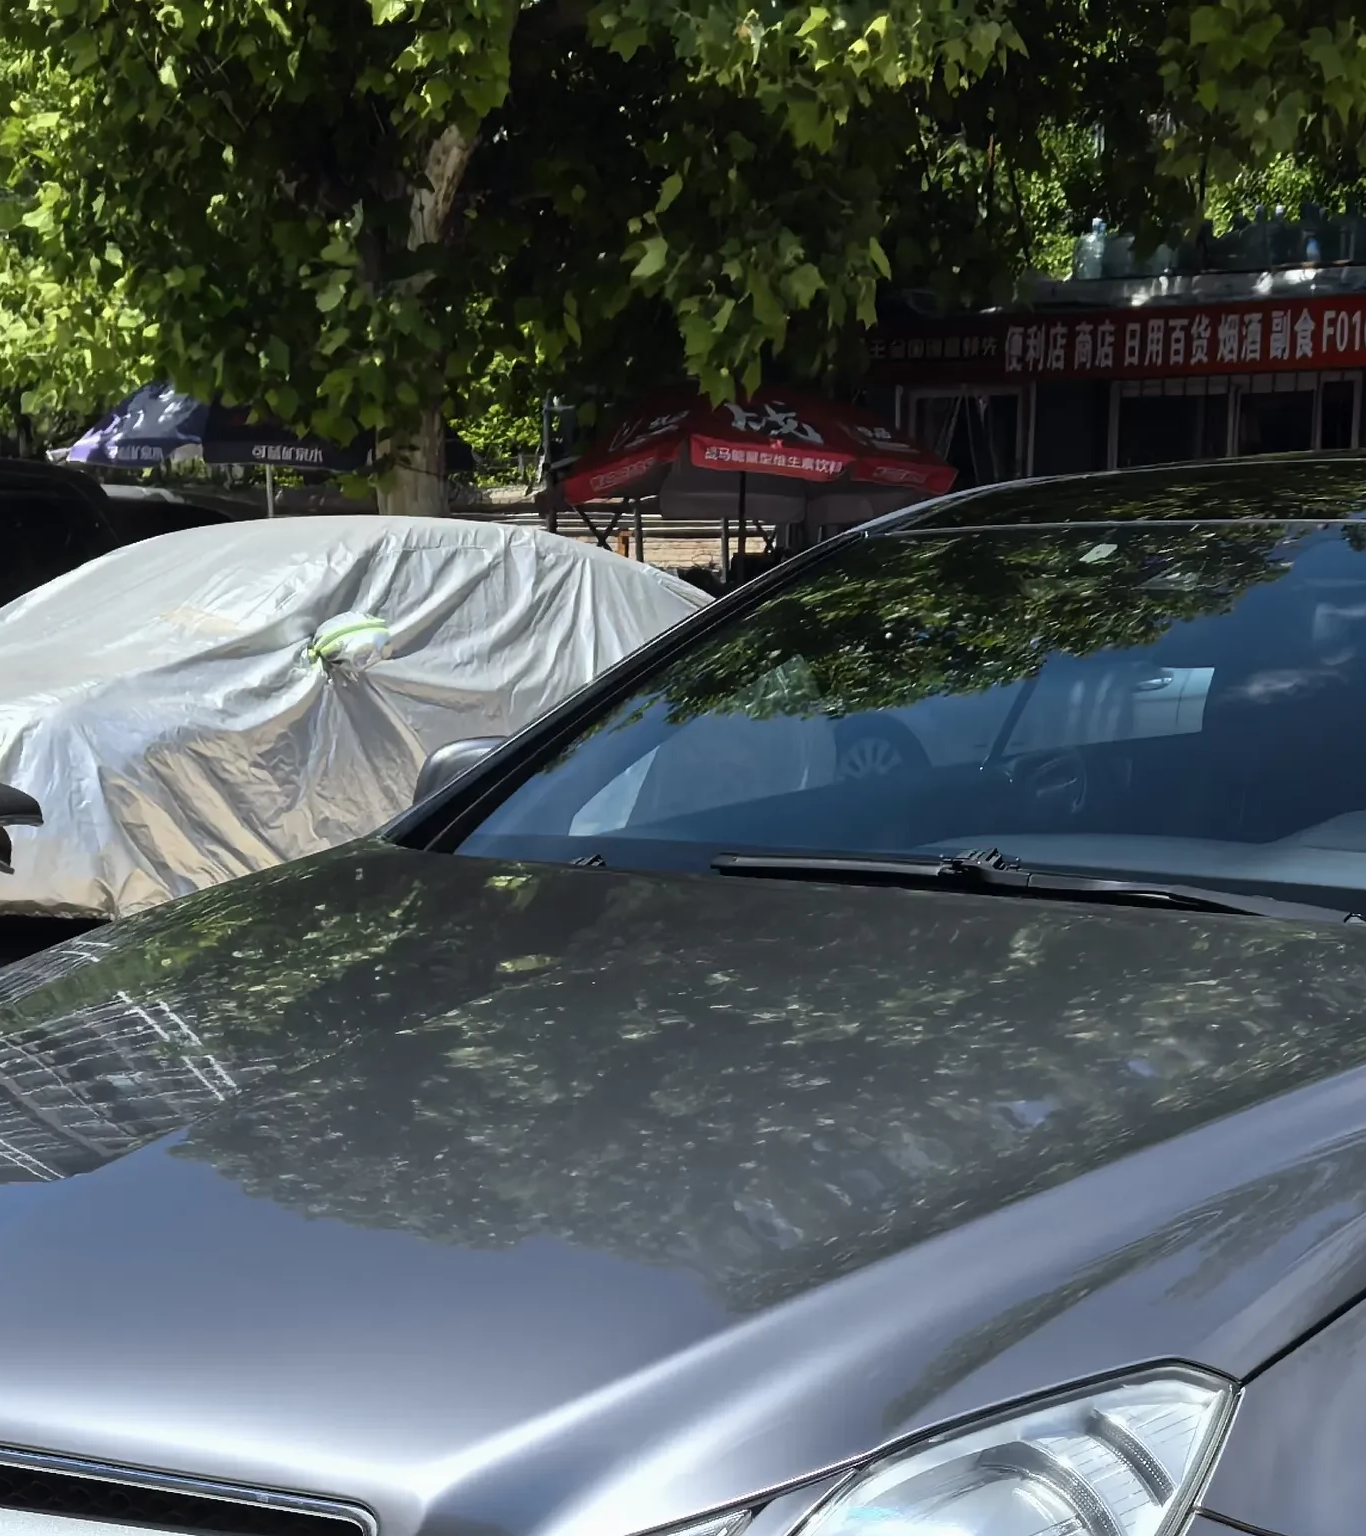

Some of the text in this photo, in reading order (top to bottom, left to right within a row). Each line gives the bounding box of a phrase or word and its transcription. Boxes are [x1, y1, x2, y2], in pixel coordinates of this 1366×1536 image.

[1005, 322, 1068, 373] 便利店
[1073, 319, 1116, 371] 商店
[1124, 314, 1212, 367] 日用百货
[1217, 312, 1263, 362] 烟酒
[1269, 308, 1316, 360] 副食
